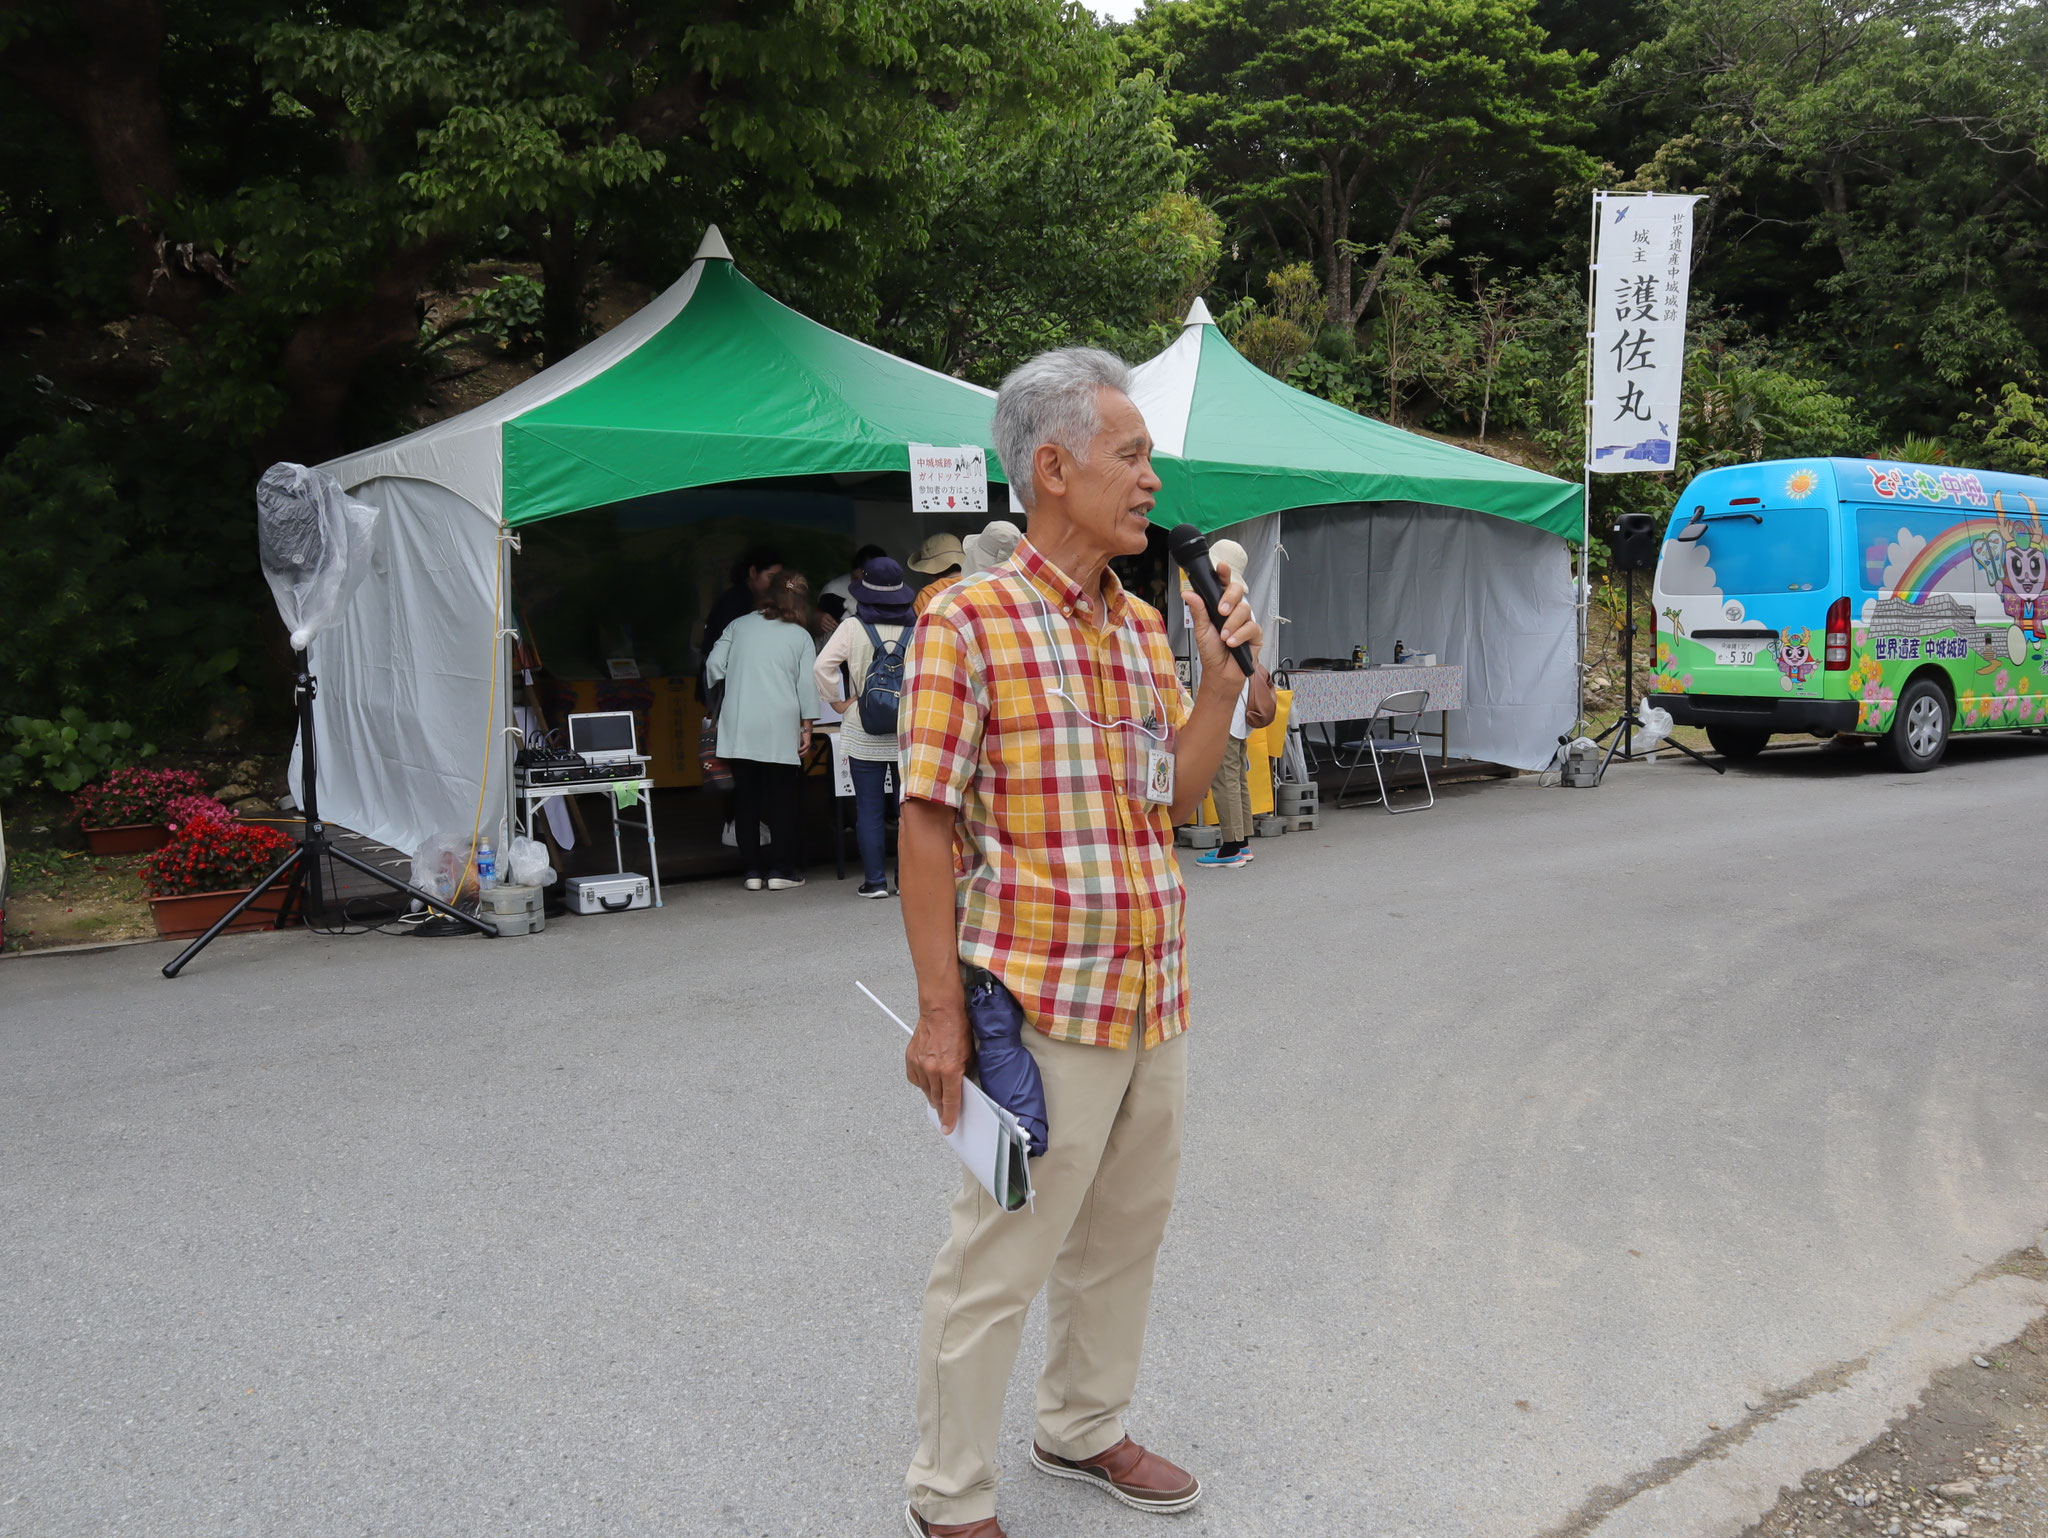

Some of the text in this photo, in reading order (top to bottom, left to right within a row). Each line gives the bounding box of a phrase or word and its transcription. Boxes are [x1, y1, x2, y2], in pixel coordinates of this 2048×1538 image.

[1663, 213, 1685, 322] 世界遺産中城城跡
[1610, 228, 1660, 423] 城主 護佐丸
[917, 457, 953, 469] 中城城跡
[918, 472, 970, 482] ガイドツアー
[918, 485, 985, 495] 参加者の方はこちら
[1875, 637, 1968, 660] 世界遺産 中城城跡
